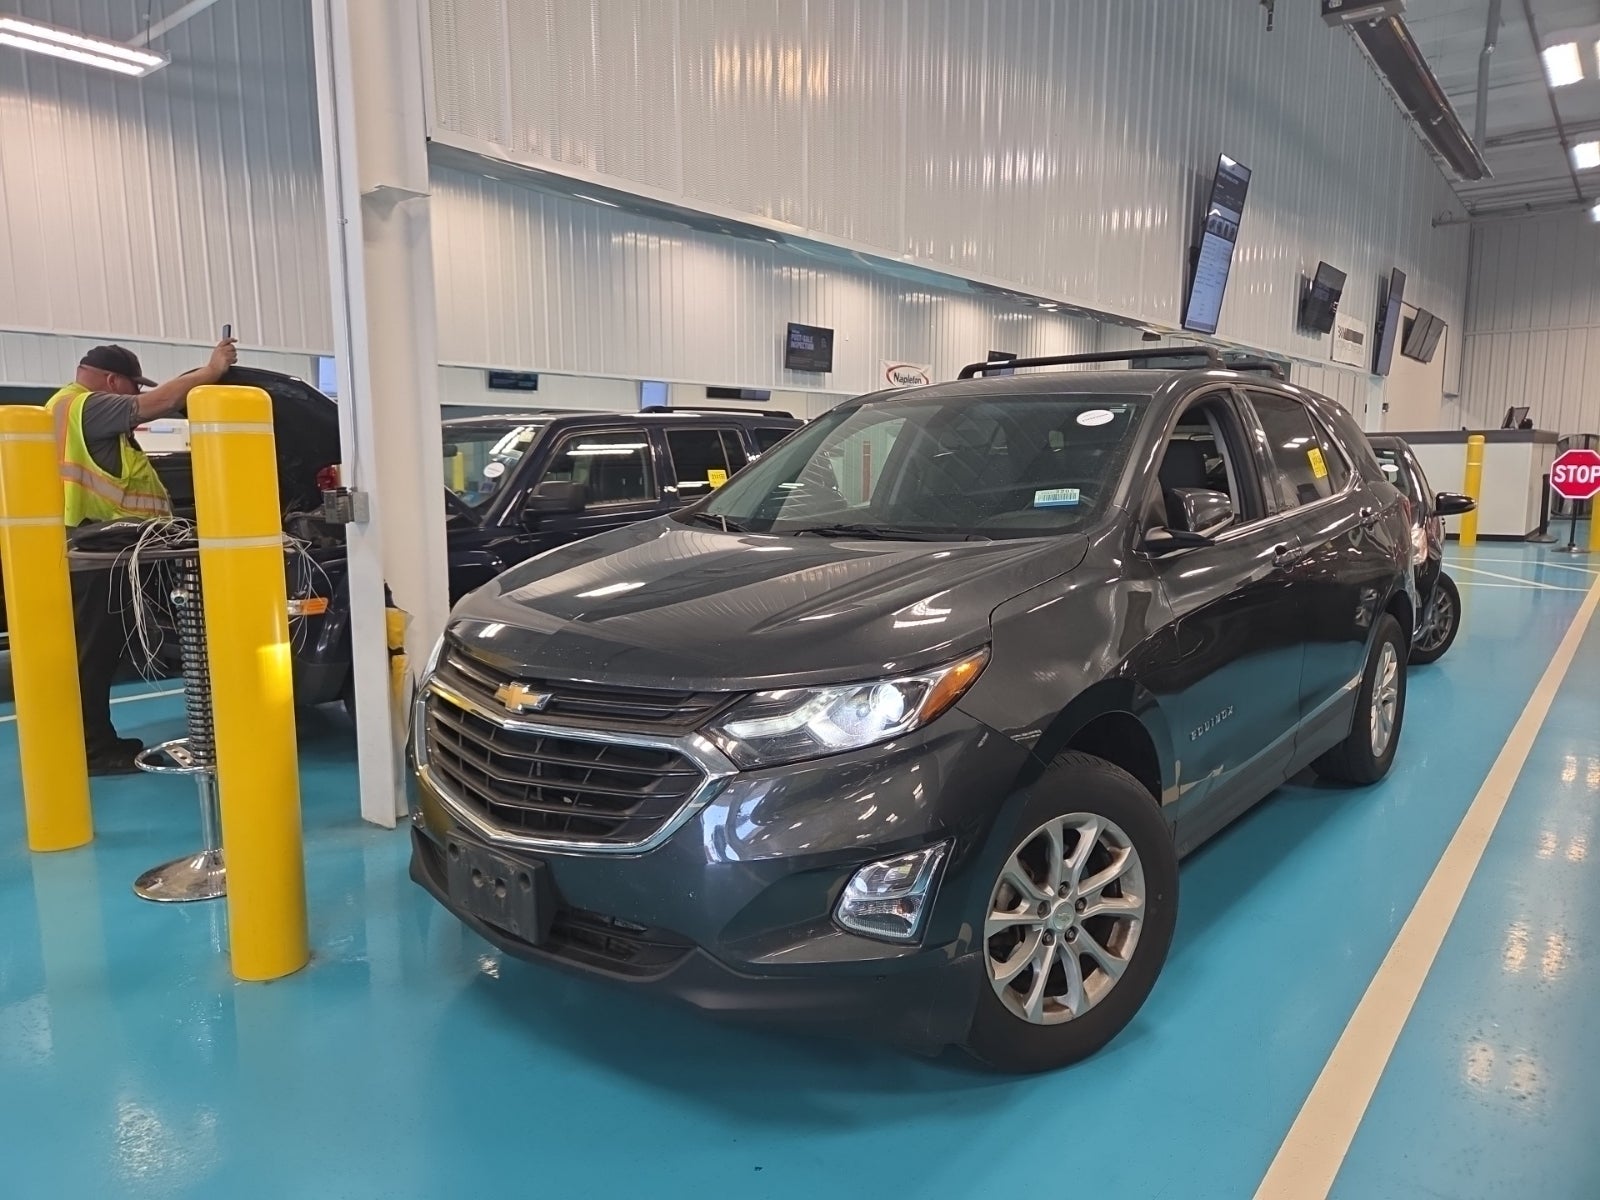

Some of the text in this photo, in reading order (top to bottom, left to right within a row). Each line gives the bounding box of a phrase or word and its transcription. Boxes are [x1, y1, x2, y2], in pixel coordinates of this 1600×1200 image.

[893, 372, 922, 385] Napleton
[1554, 464, 1600, 484] STOP
[1191, 705, 1233, 741] EQUINOX
